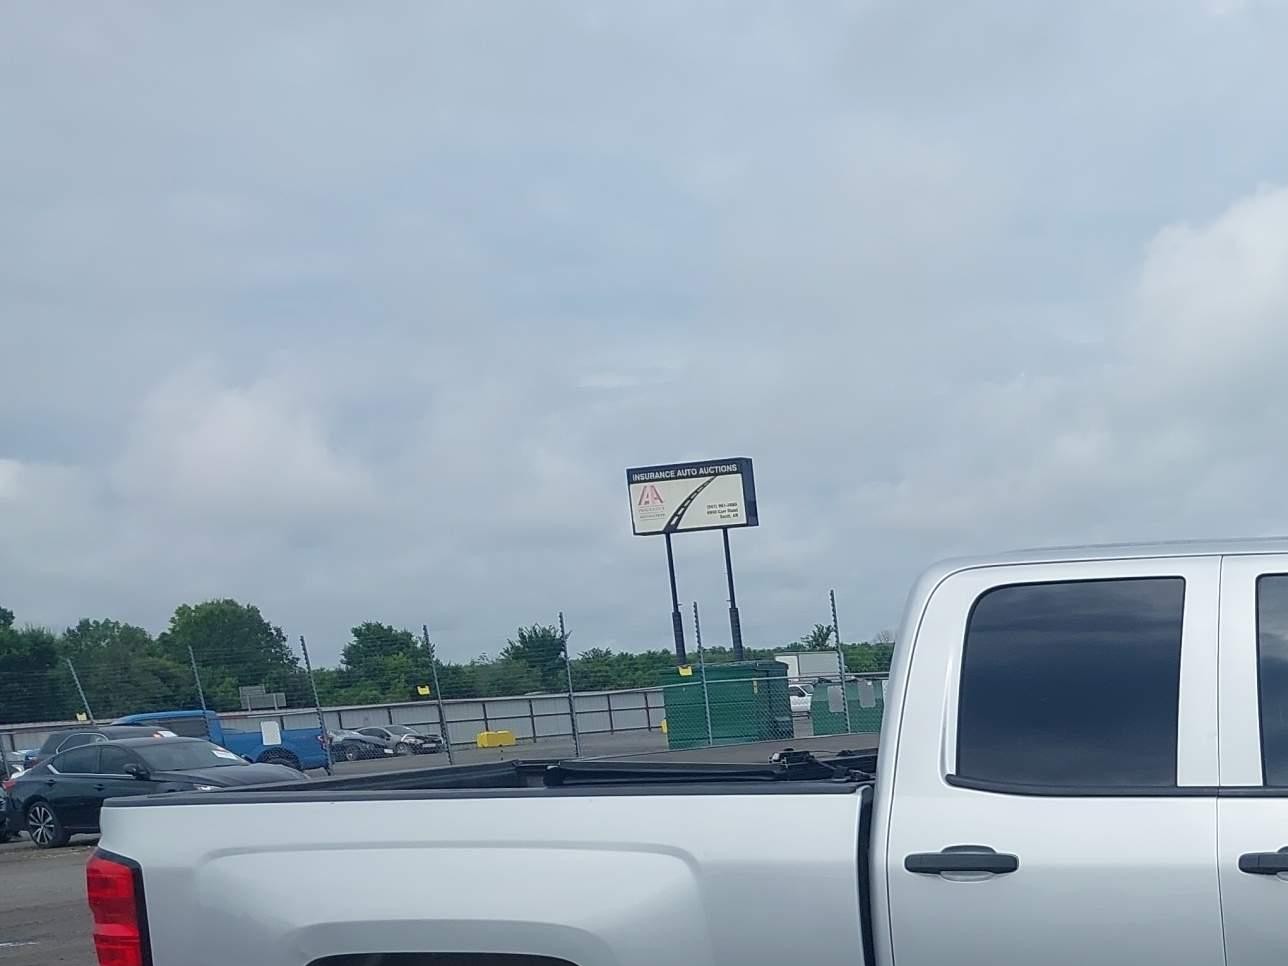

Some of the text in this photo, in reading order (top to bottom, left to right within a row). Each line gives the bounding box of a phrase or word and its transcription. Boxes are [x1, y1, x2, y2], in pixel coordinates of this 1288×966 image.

[632, 464, 738, 481] INSURANCE AUTO AUCTIONS
